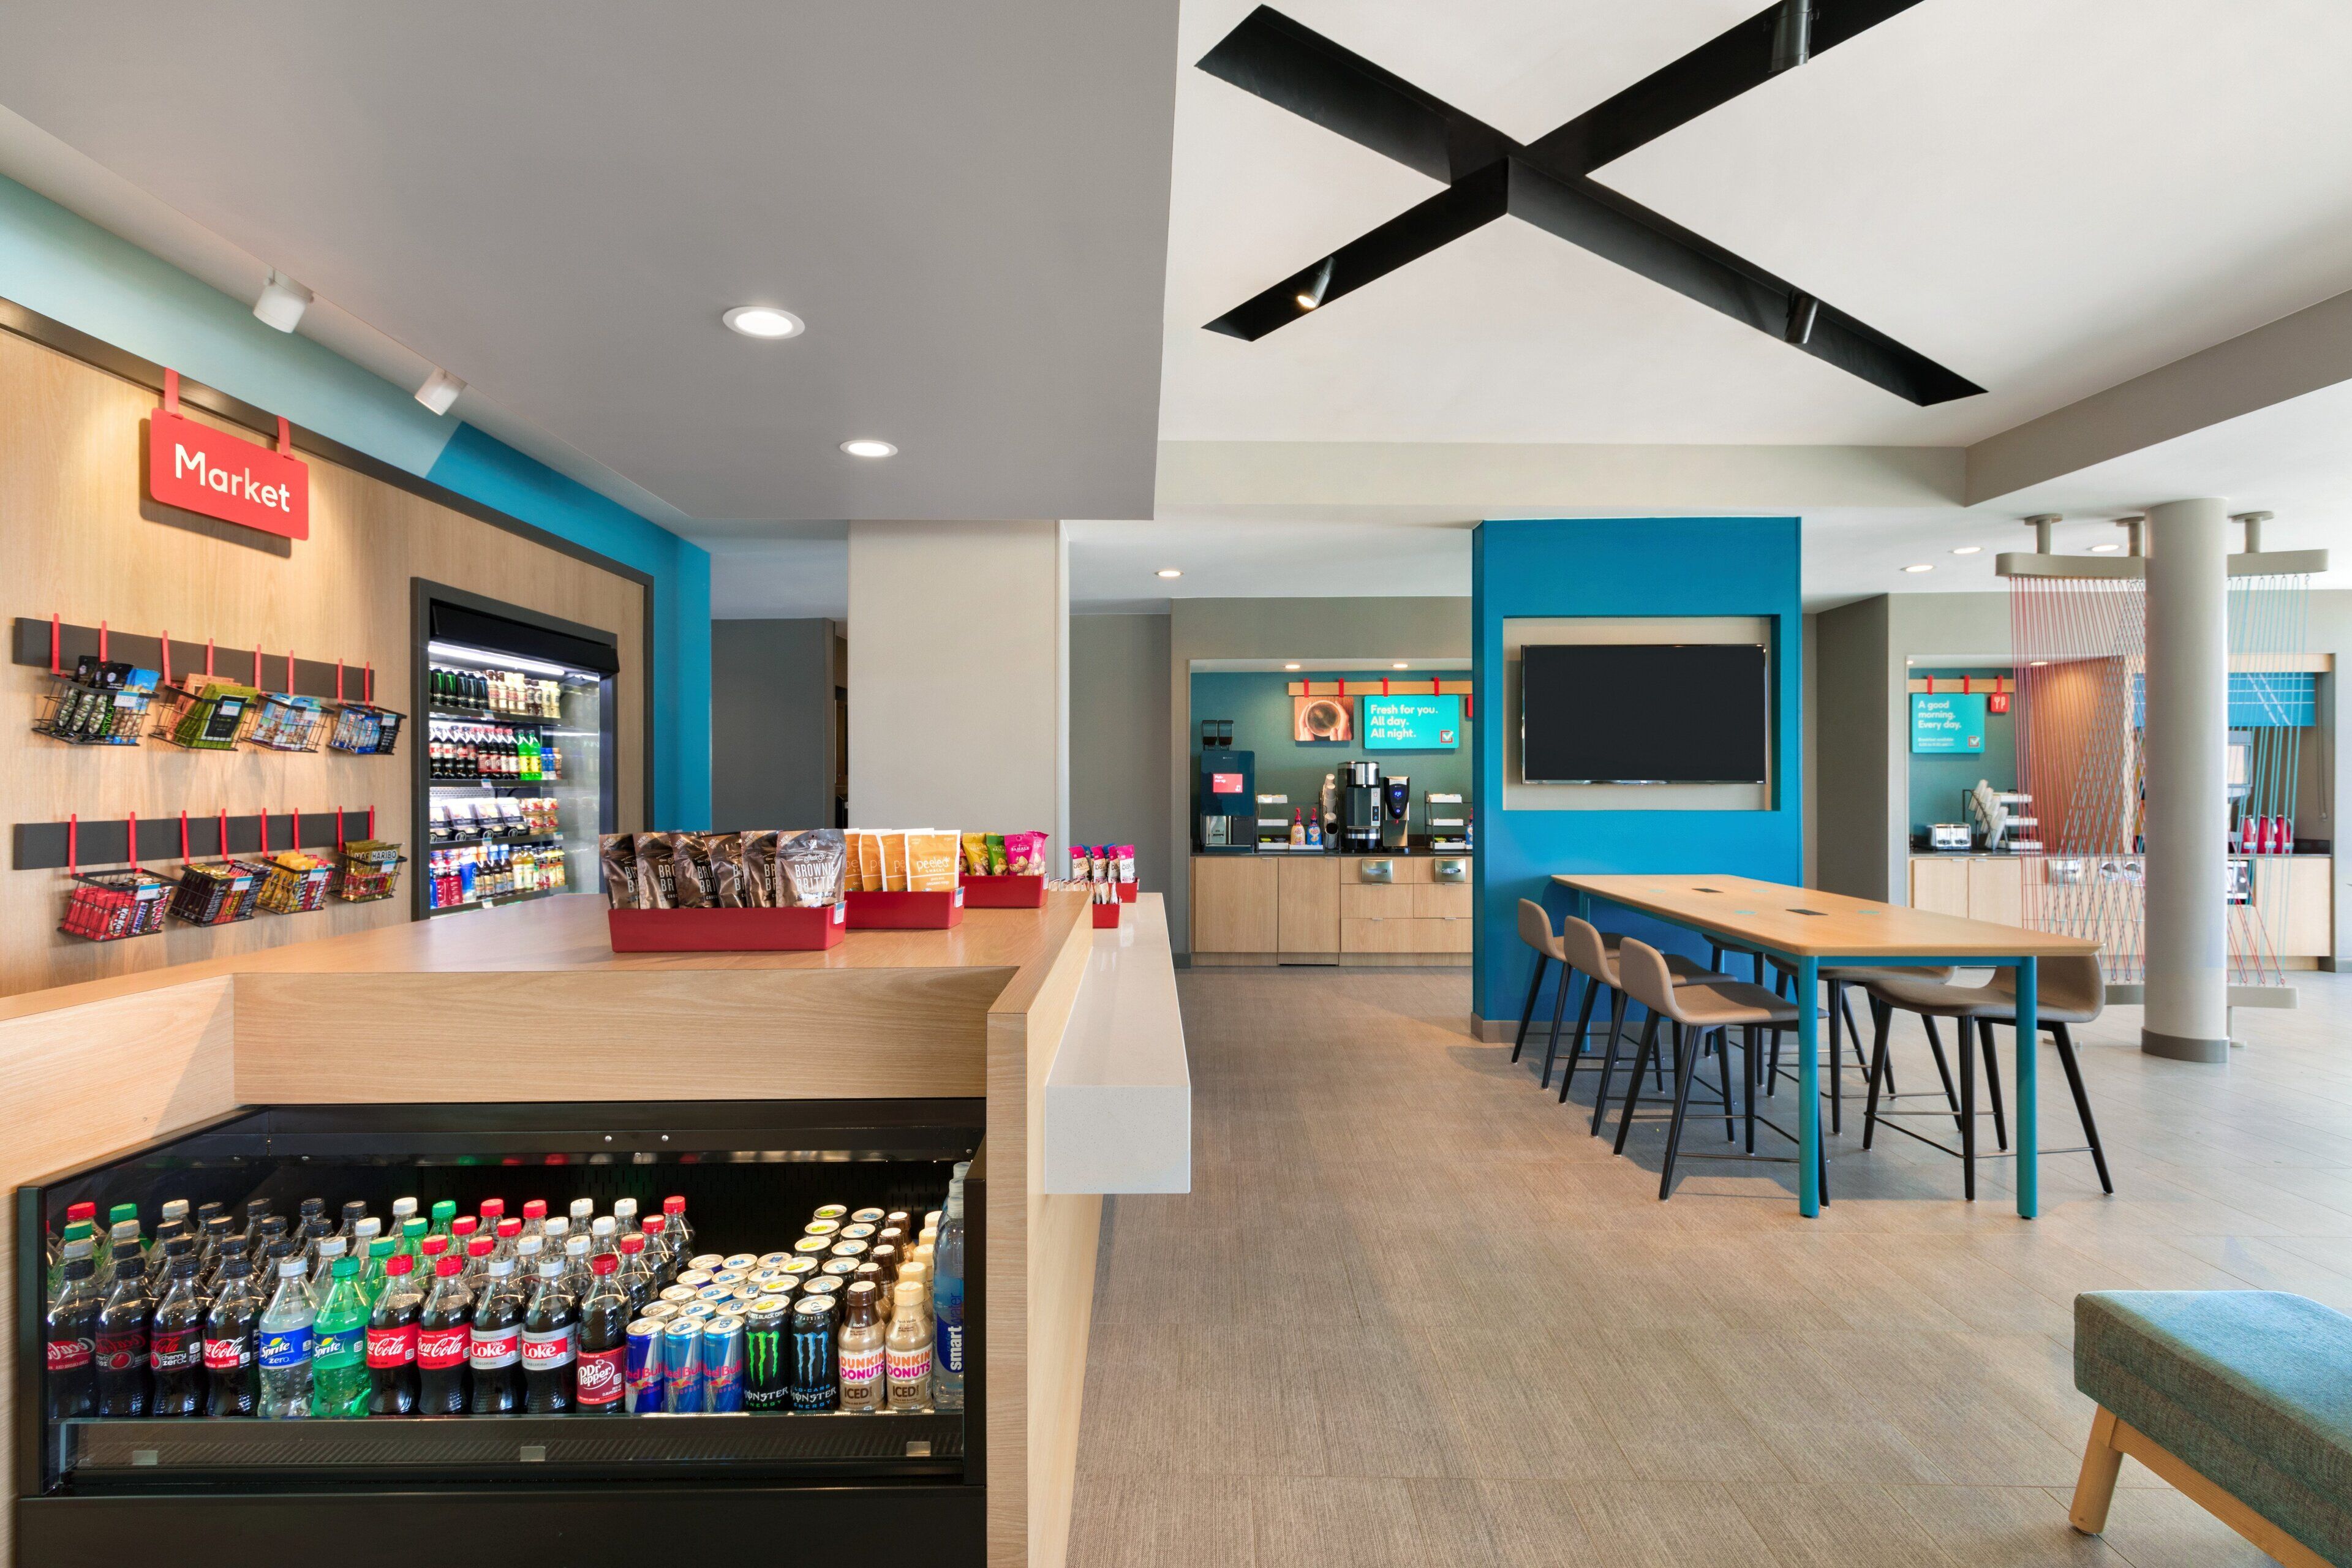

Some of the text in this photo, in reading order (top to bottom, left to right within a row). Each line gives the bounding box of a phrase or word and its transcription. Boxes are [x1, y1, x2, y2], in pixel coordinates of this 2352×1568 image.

[175, 443, 290, 512] Market
[1370, 704, 1438, 717] Fresh for you.
[1928, 701, 1950, 710] good
[1370, 716, 1409, 728] All day.
[1918, 710, 1956, 720] morning.
[1918, 720, 1962, 730] Every day.
[1370, 728, 1416, 740] All night.
[371, 850, 397, 861] HARIBO
[794, 862, 835, 878] BROWNIE
[916, 857, 949, 872] peeled
[796, 876, 835, 892] BRITTLE
[261, 1341, 290, 1359] Sprite
[314, 1343, 341, 1359] Sprite
[471, 1341, 506, 1357] Coke
[522, 1343, 556, 1358] Coke
[886, 1348, 932, 1367] DUNKIN'
[586, 1365, 601, 1374] Dr
[642, 1362, 663, 1379] Bull
[682, 1360, 703, 1378] Bull
[722, 1359, 742, 1377] Bull
[841, 1360, 884, 1379] DONUTS
[888, 1360, 930, 1378] DONUTS
[578, 1366, 612, 1387] Pepper
[794, 1384, 831, 1392] LO-CARB
[844, 1387, 869, 1399] ICED
[892, 1385, 916, 1398] ICED
[793, 1400, 831, 1409] ENERGY
